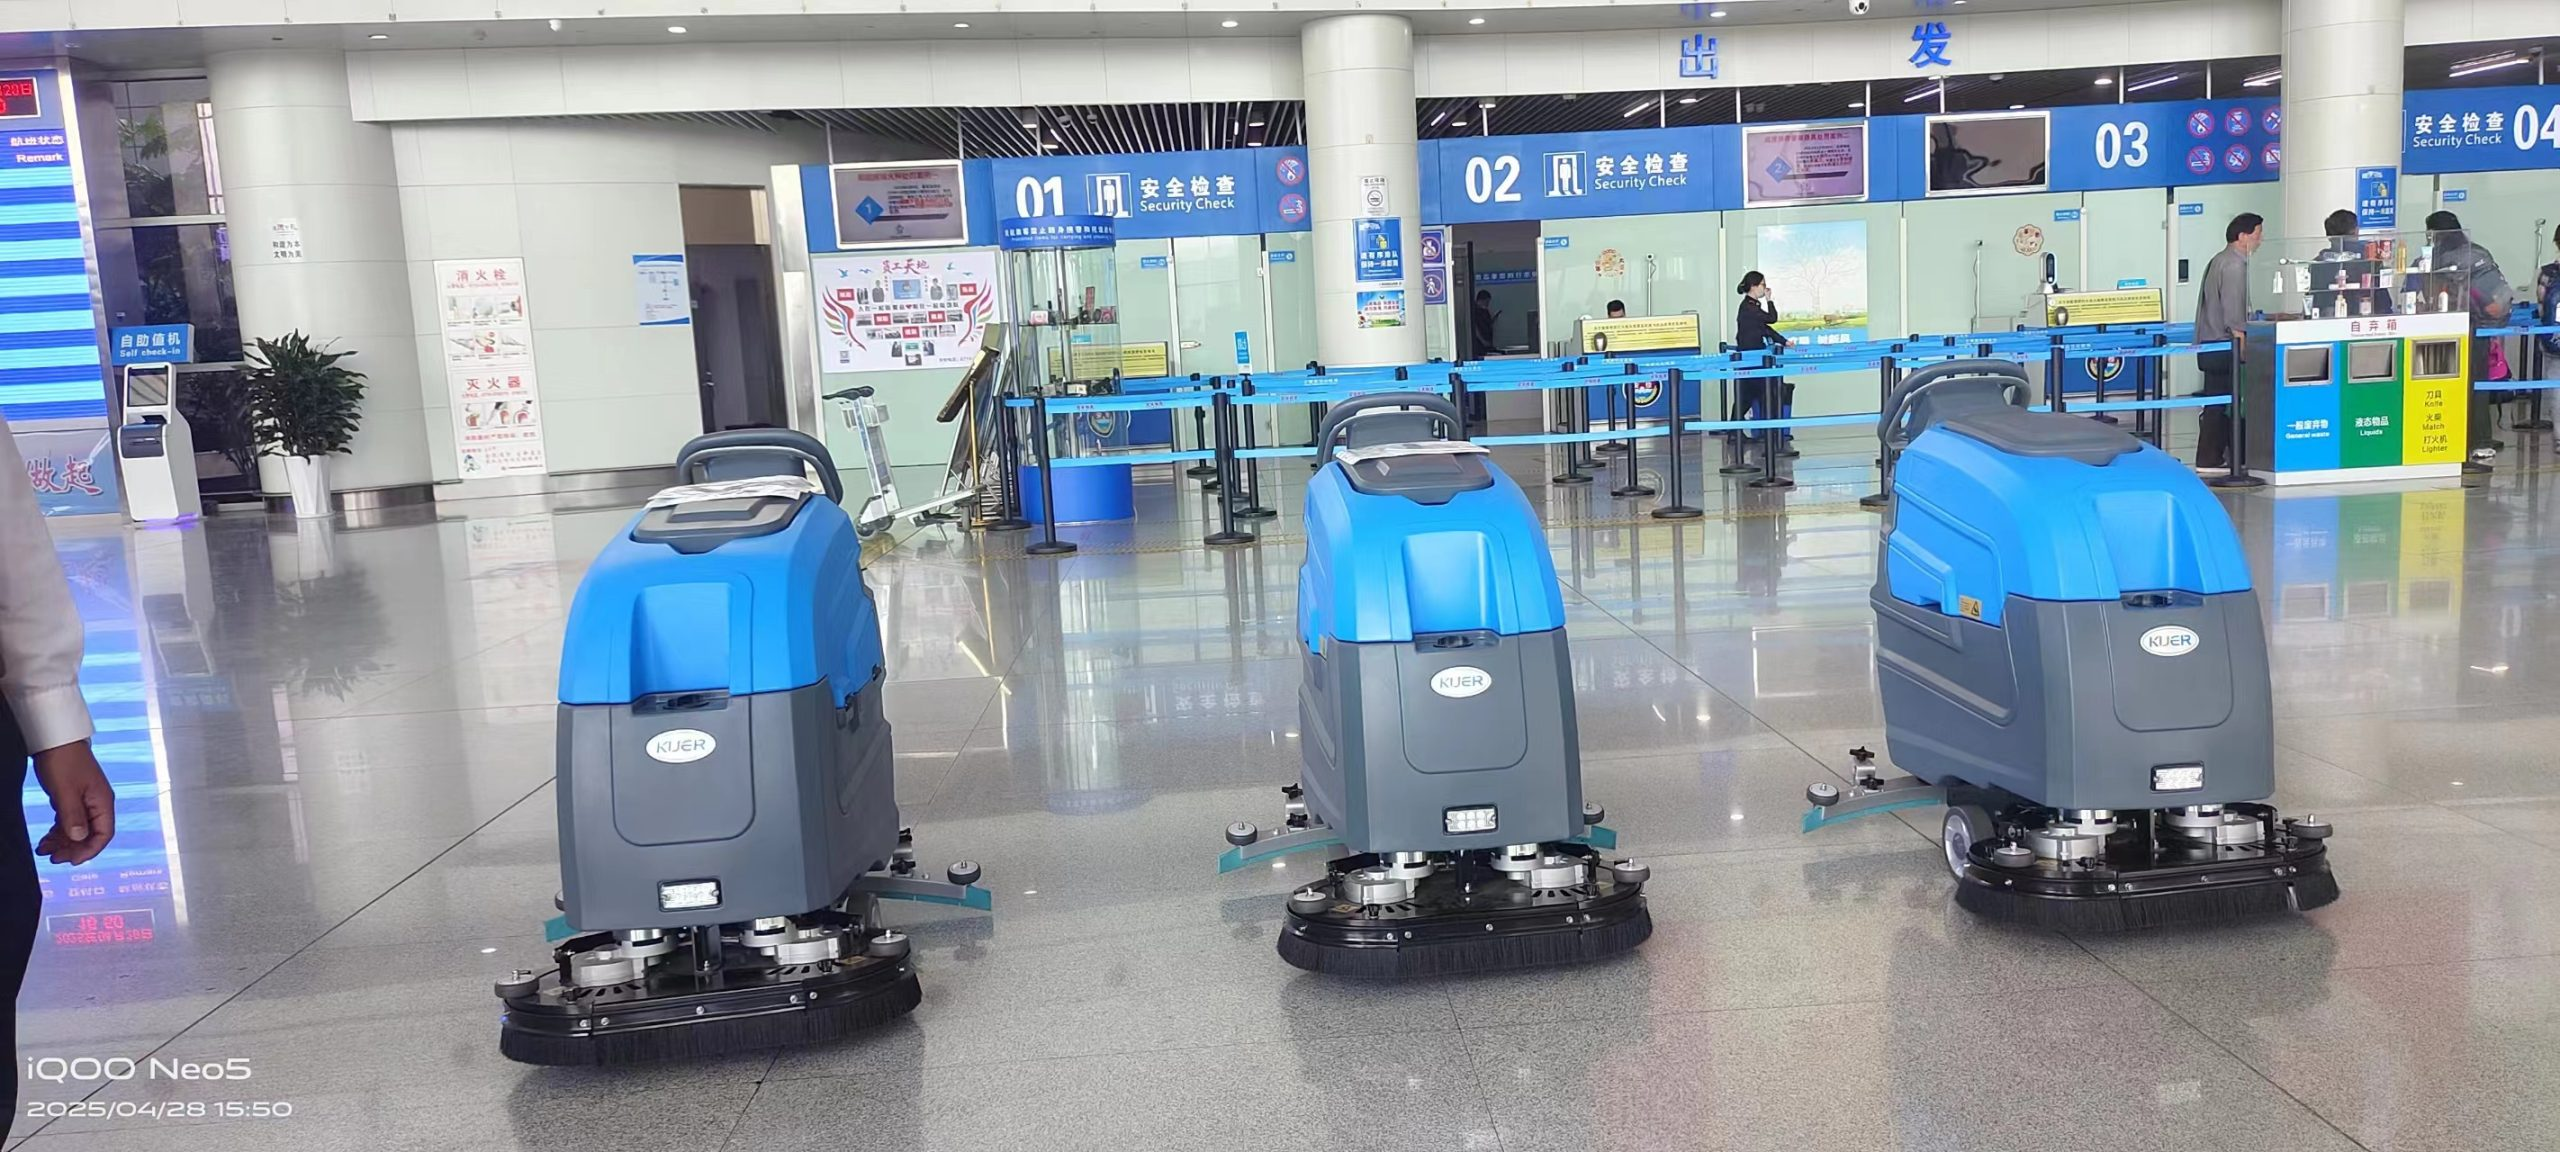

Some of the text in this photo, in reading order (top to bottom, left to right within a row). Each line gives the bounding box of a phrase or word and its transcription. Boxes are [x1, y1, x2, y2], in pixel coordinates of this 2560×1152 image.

[2414, 112, 2504, 134] 安全检查
[2514, 104, 2560, 150] 04
[2095, 121, 2149, 169] 03
[2413, 134, 2502, 149] Security Check
[16, 153, 64, 163] Remark
[1595, 152, 1689, 177] 安全检查
[1139, 174, 1235, 199] 安全检查
[1465, 154, 1522, 204] 02
[1594, 174, 1687, 190] Security Check
[1016, 175, 1062, 217] 01
[1139, 197, 1235, 213] Security Check
[883, 258, 929, 275] 员工天地
[456, 268, 507, 283] 消火栓
[2351, 319, 2397, 333] 自弃箱
[120, 332, 181, 348] 自助值机
[120, 347, 181, 358] Self check-in
[466, 376, 521, 390] 灭火器
[2426, 390, 2442, 400] 刀具
[2287, 419, 2329, 431] 一般废弃物
[2355, 416, 2390, 428] 液态物品
[2426, 413, 2442, 423] 火柴
[2423, 423, 2445, 431] Match
[2424, 435, 2448, 445] 打火机
[2422, 445, 2448, 454] Lighter
